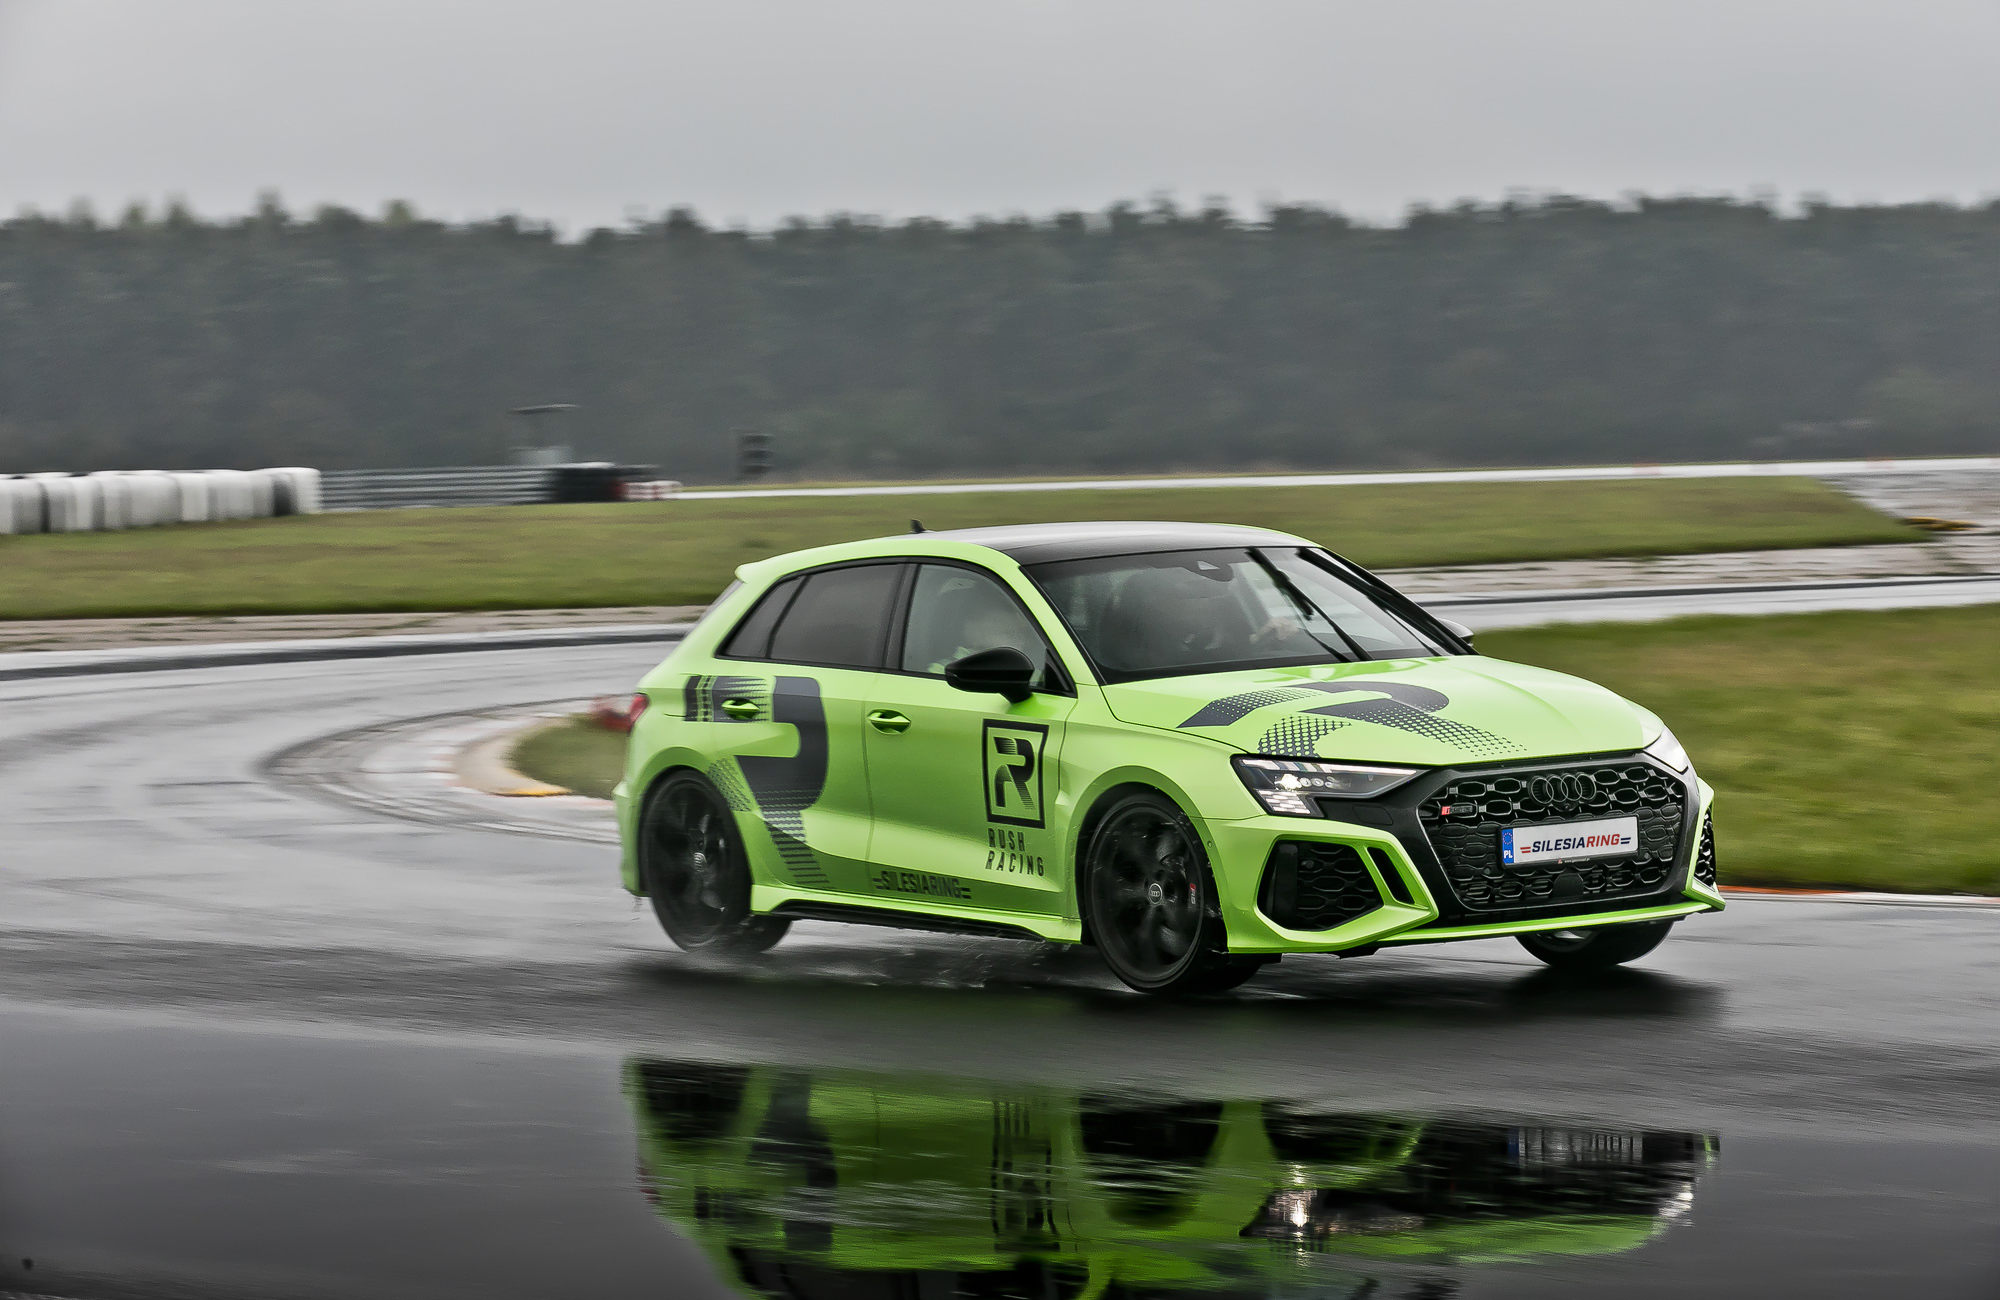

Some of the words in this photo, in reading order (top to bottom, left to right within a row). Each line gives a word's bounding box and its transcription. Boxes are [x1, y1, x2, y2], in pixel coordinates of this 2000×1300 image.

[988, 828, 1025, 851] RUSH
[1532, 834, 1620, 853] SILESIARING
[985, 850, 1045, 877] RACING
[1504, 850, 1513, 859] PL
